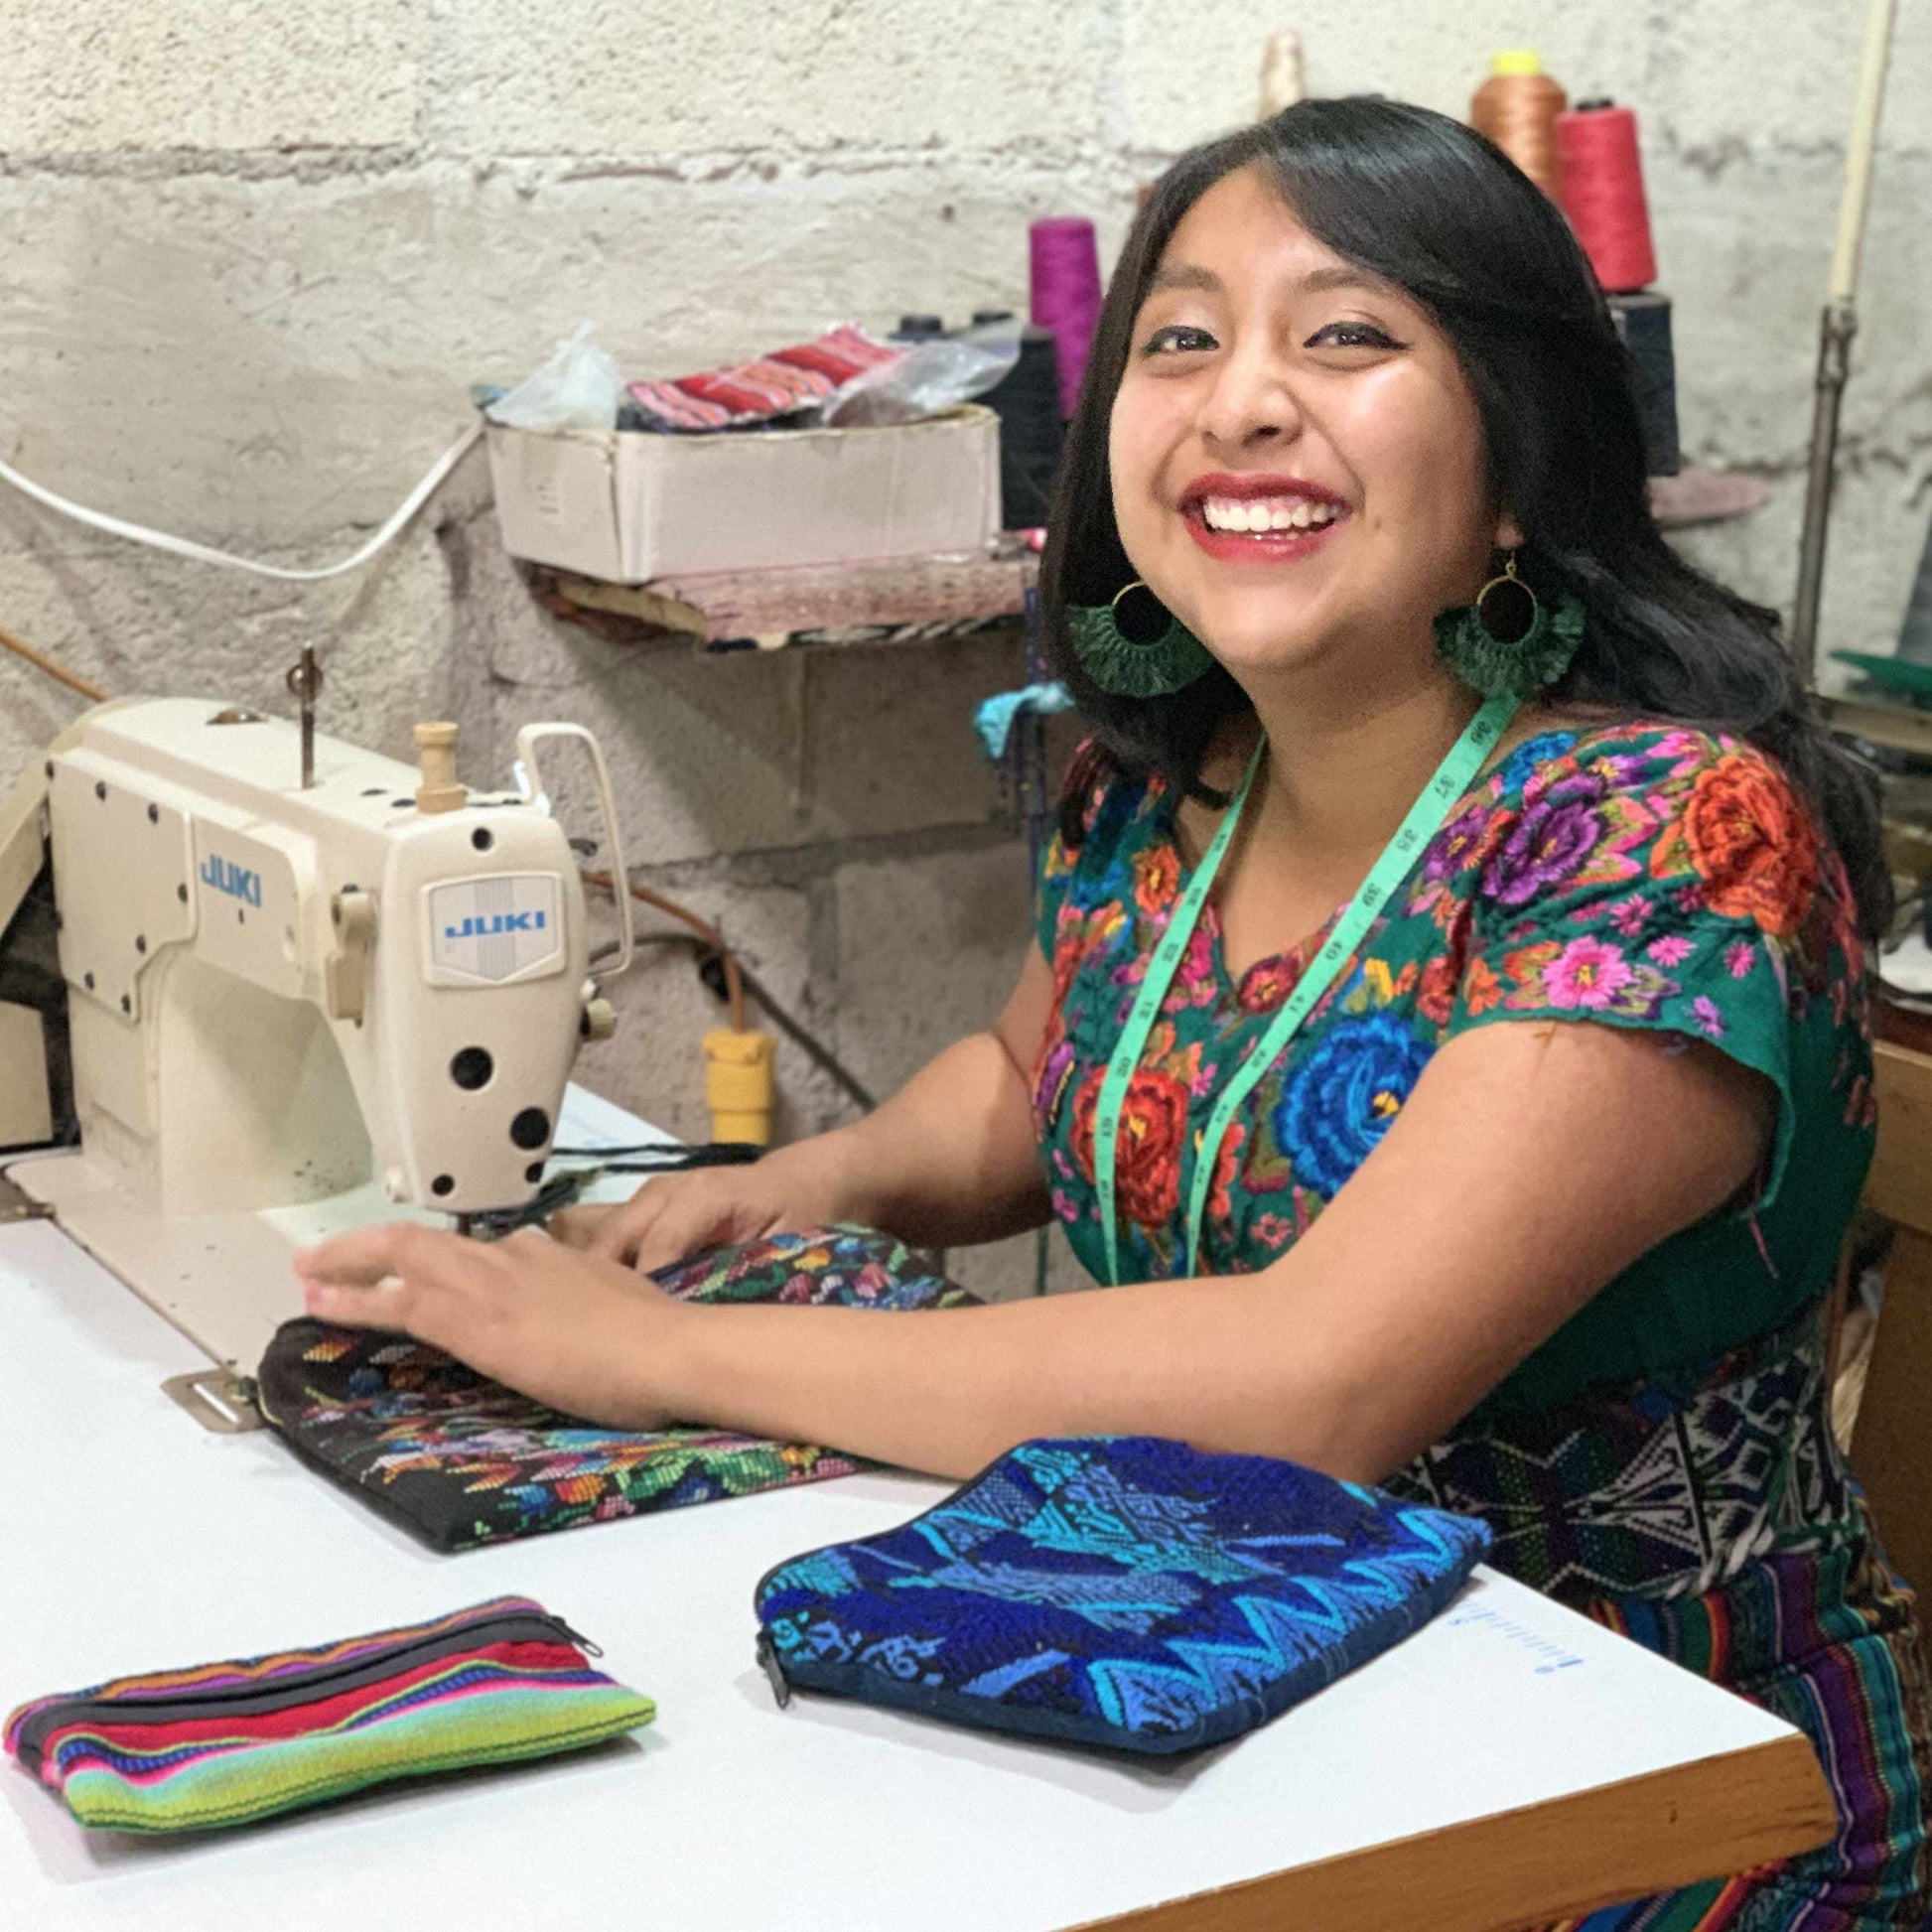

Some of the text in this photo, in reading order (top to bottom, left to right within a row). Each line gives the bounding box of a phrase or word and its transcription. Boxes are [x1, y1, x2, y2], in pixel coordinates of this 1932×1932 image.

[1470, 721, 1491, 746] 36
[1435, 774, 1455, 799] 37
[1396, 829, 1419, 852] 38
[201, 854, 261, 908] JUKI
[1361, 883, 1381, 906] 39
[445, 910, 546, 938] JUKI
